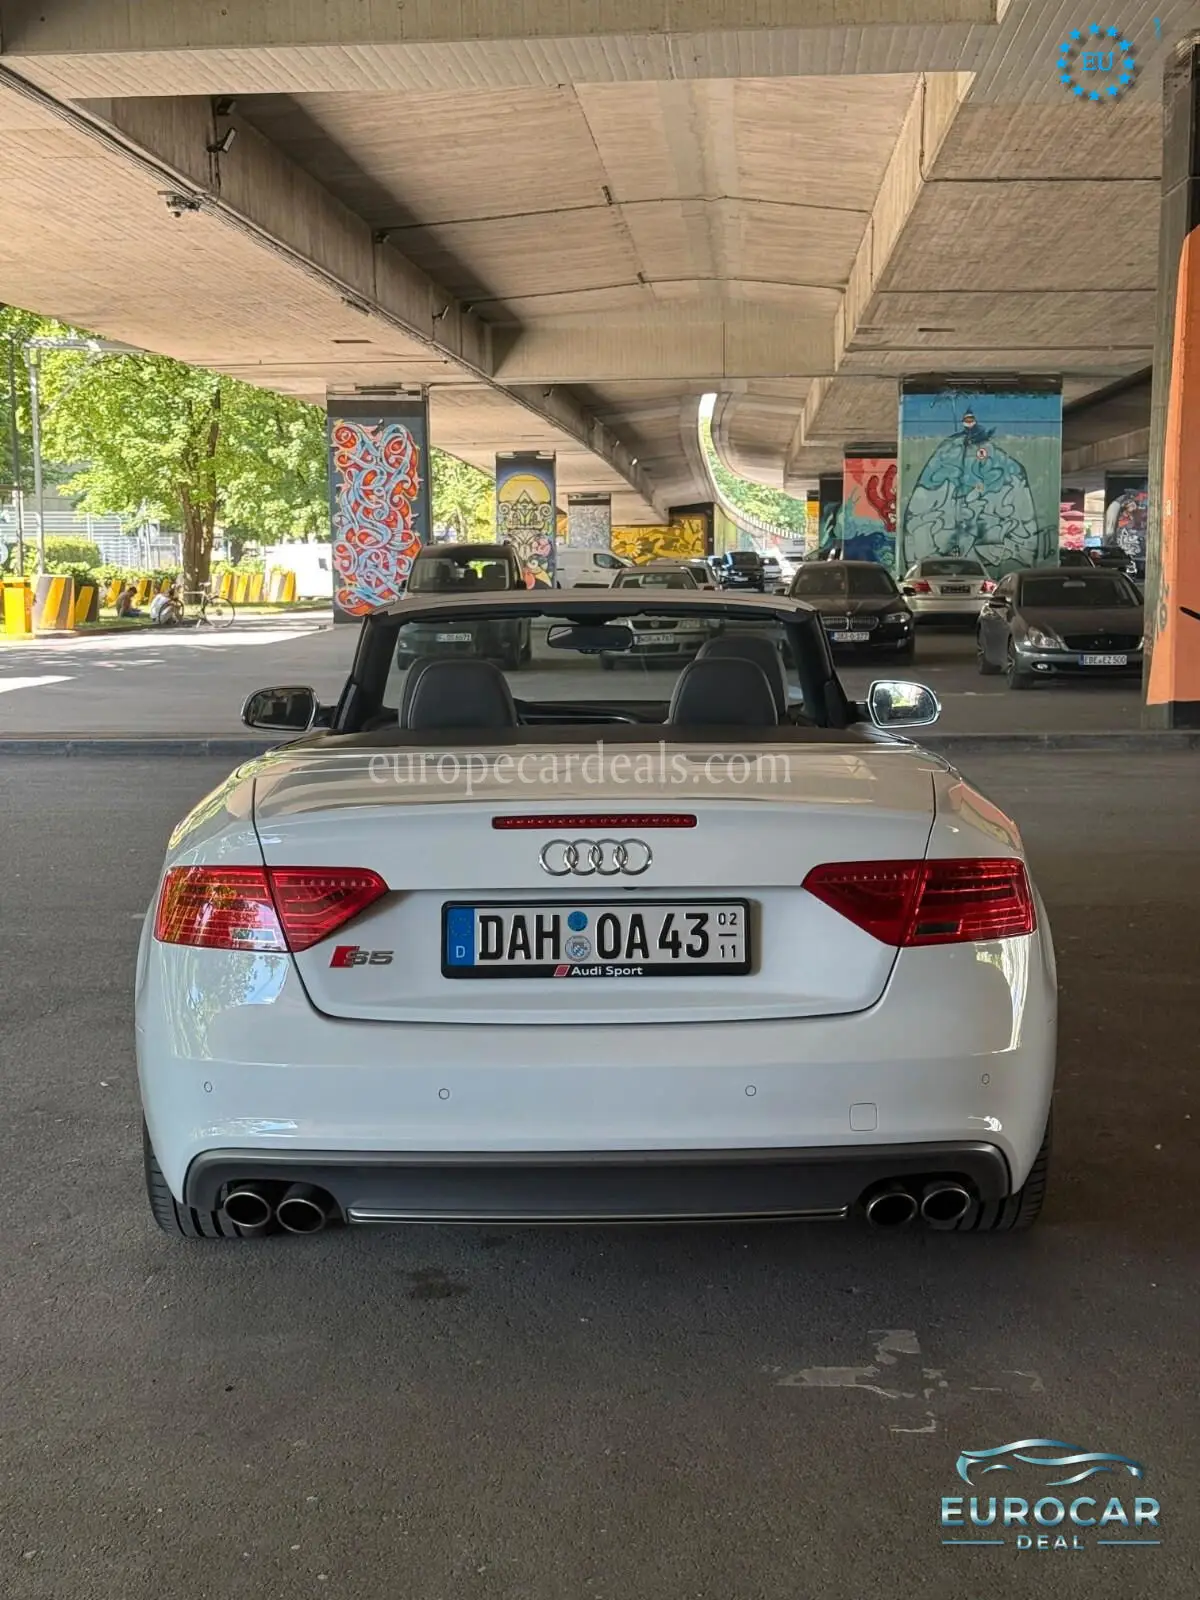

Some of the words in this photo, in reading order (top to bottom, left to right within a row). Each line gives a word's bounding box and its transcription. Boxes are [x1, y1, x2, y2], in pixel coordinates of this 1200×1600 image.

[717, 912, 738, 926] 02
[478, 913, 561, 960] DAH
[657, 911, 710, 960] 43
[340, 948, 395, 966] S5
[455, 945, 466, 959] D
[719, 944, 738, 959] 11
[571, 965, 602, 977] Audi
[606, 965, 644, 979] Sport
